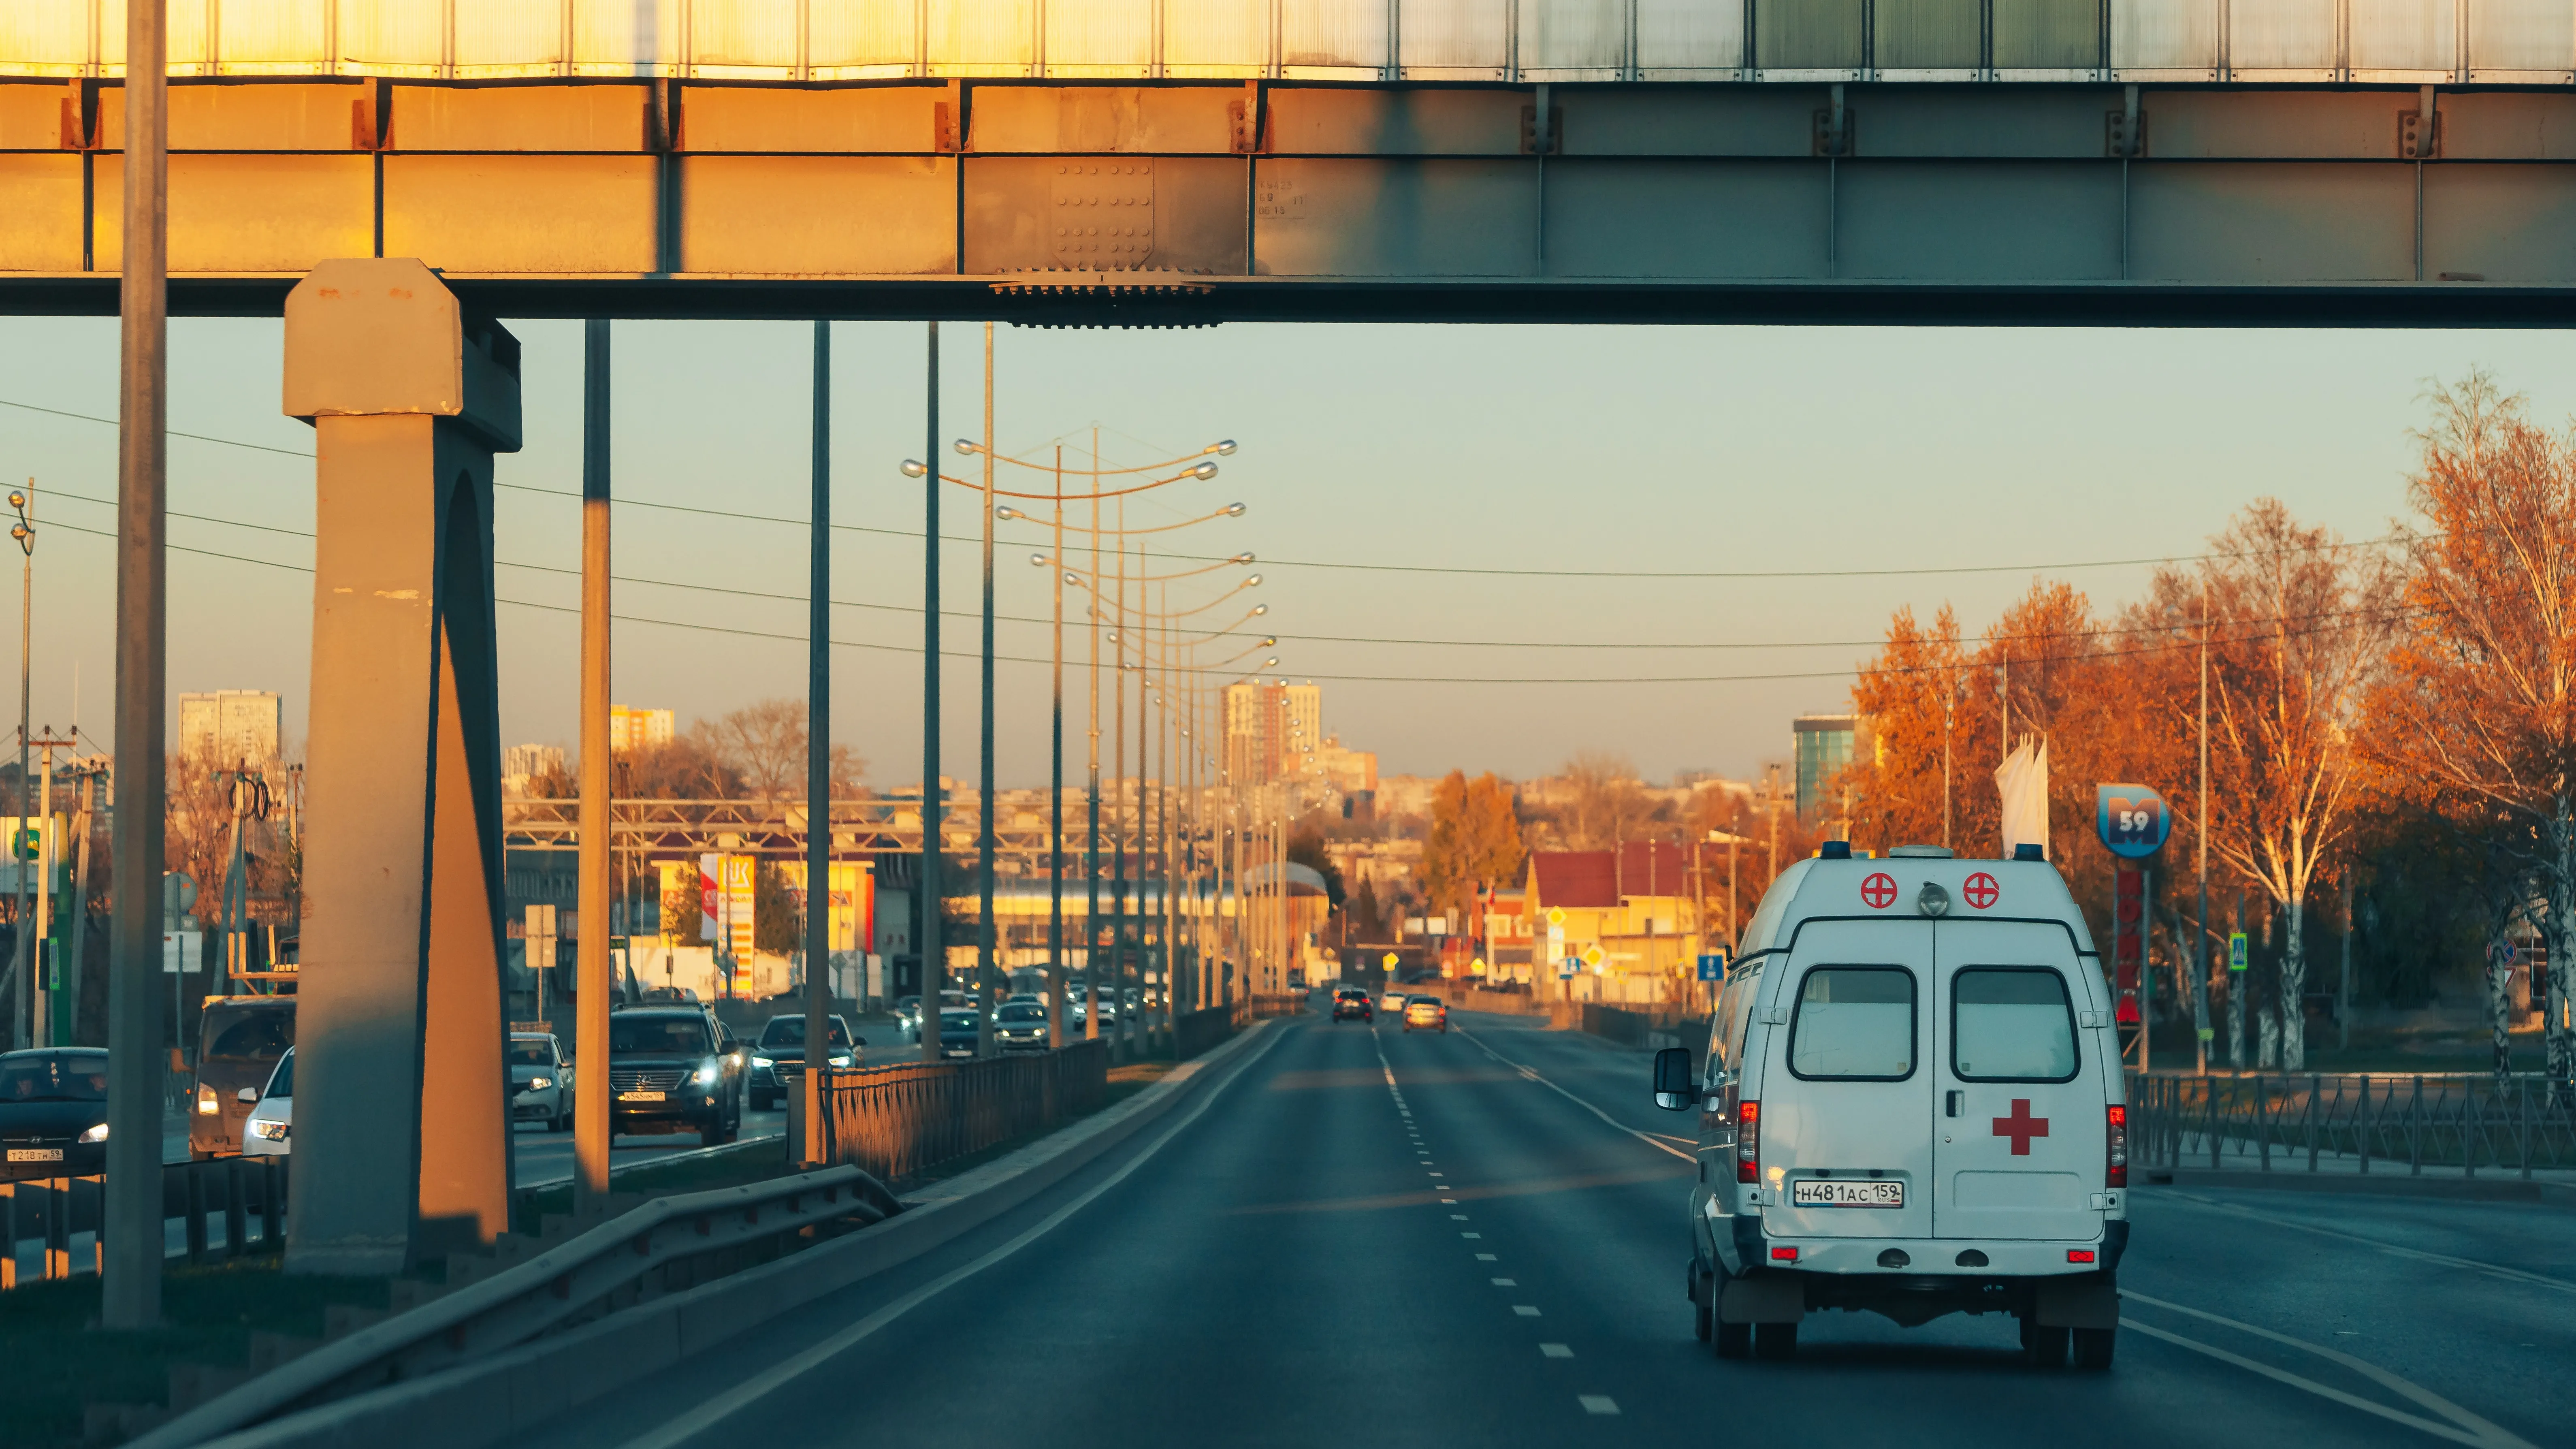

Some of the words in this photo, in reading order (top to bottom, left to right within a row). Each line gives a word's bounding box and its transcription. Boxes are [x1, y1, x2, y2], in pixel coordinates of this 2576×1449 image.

[2119, 811, 2150, 832] 59
[1802, 1185, 1868, 1201] Н481АС
[1872, 1185, 1897, 1197] 159
